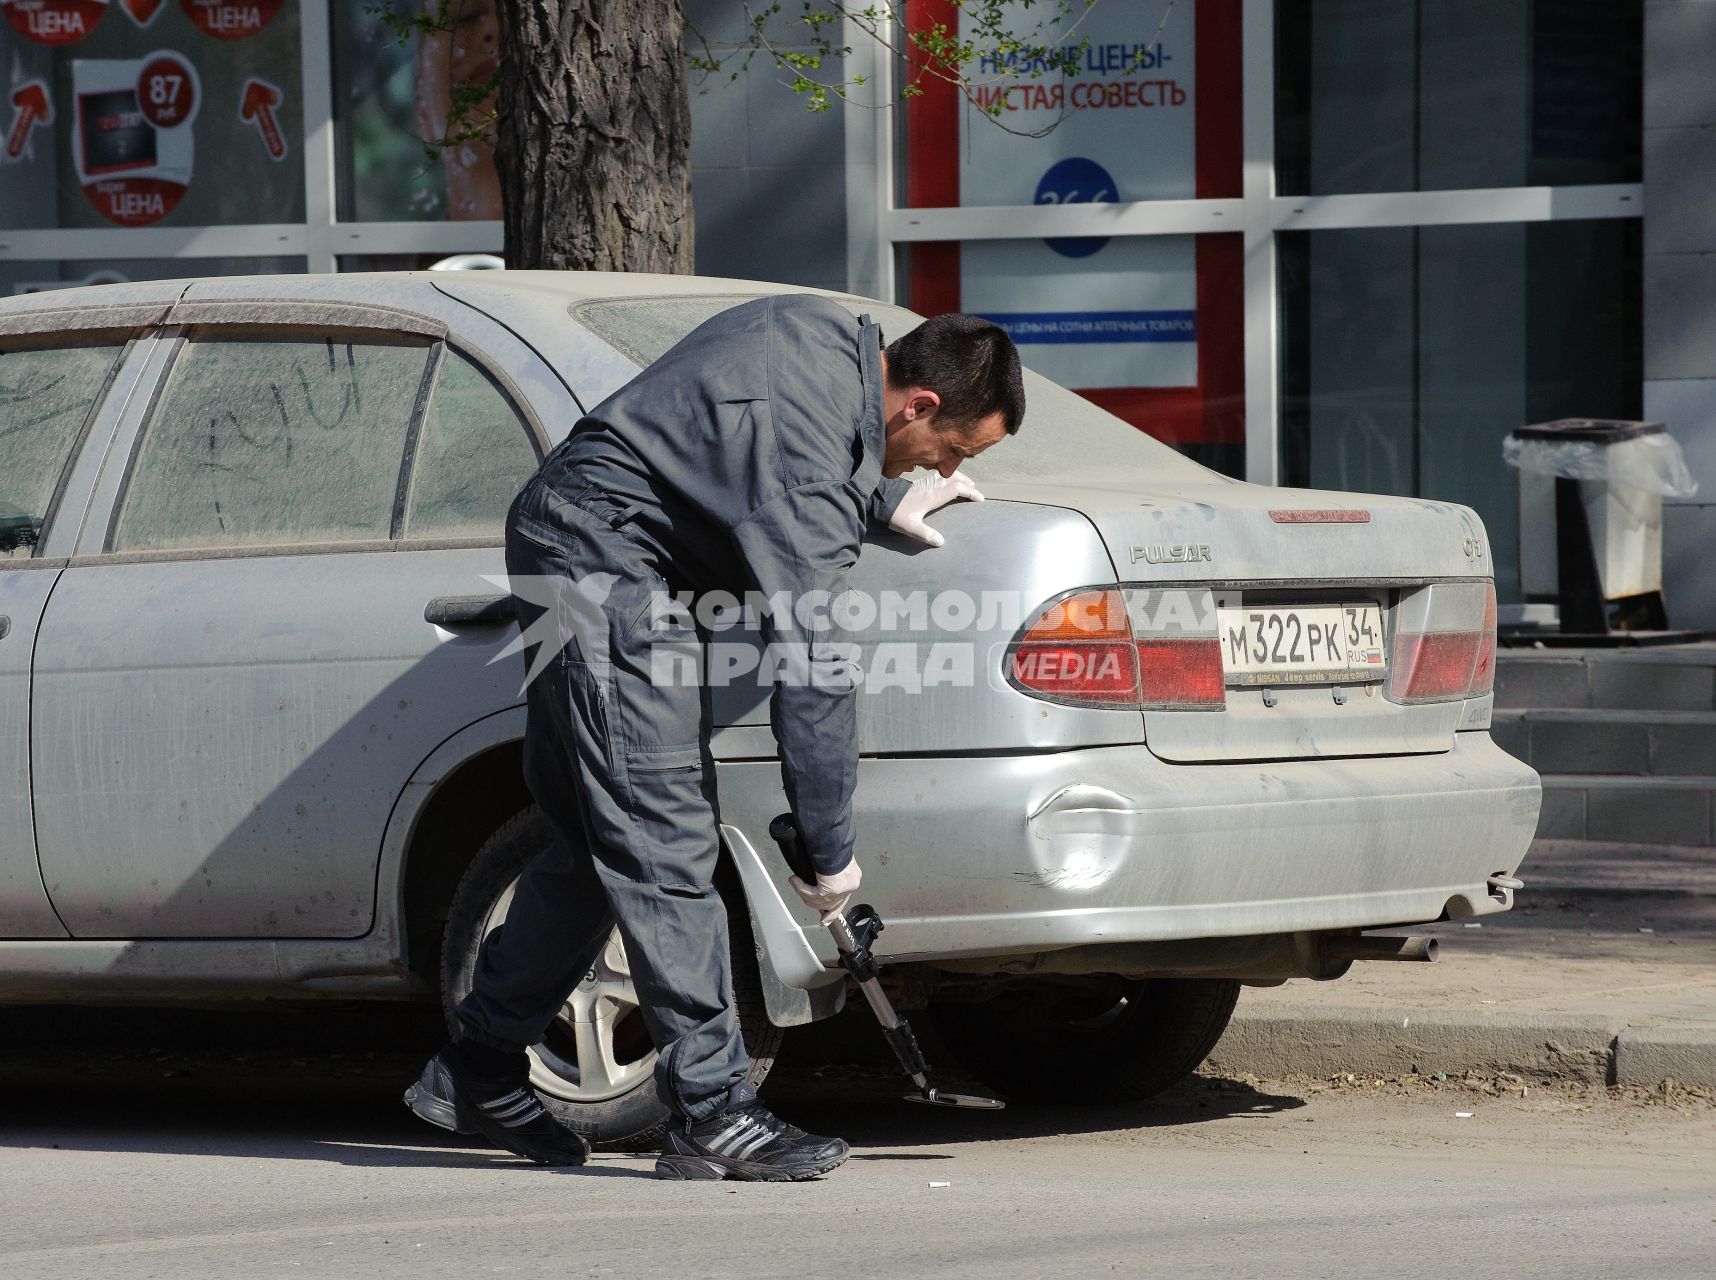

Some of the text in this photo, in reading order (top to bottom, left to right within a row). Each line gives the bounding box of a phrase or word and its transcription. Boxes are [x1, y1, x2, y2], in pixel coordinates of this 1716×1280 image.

[28, 11, 84, 37] ЦЕНА
[208, 7, 260, 31] ЦЕНА
[150, 75, 182, 104] 87
[967, 80, 1186, 111] ЧИСТАЯ СОВЕСТЬ
[112, 192, 164, 217] ЦЕНА
[1129, 544, 1212, 564] PULSAR
[1346, 608, 1374, 646] 34
[1348, 650, 1367, 663] RUS
